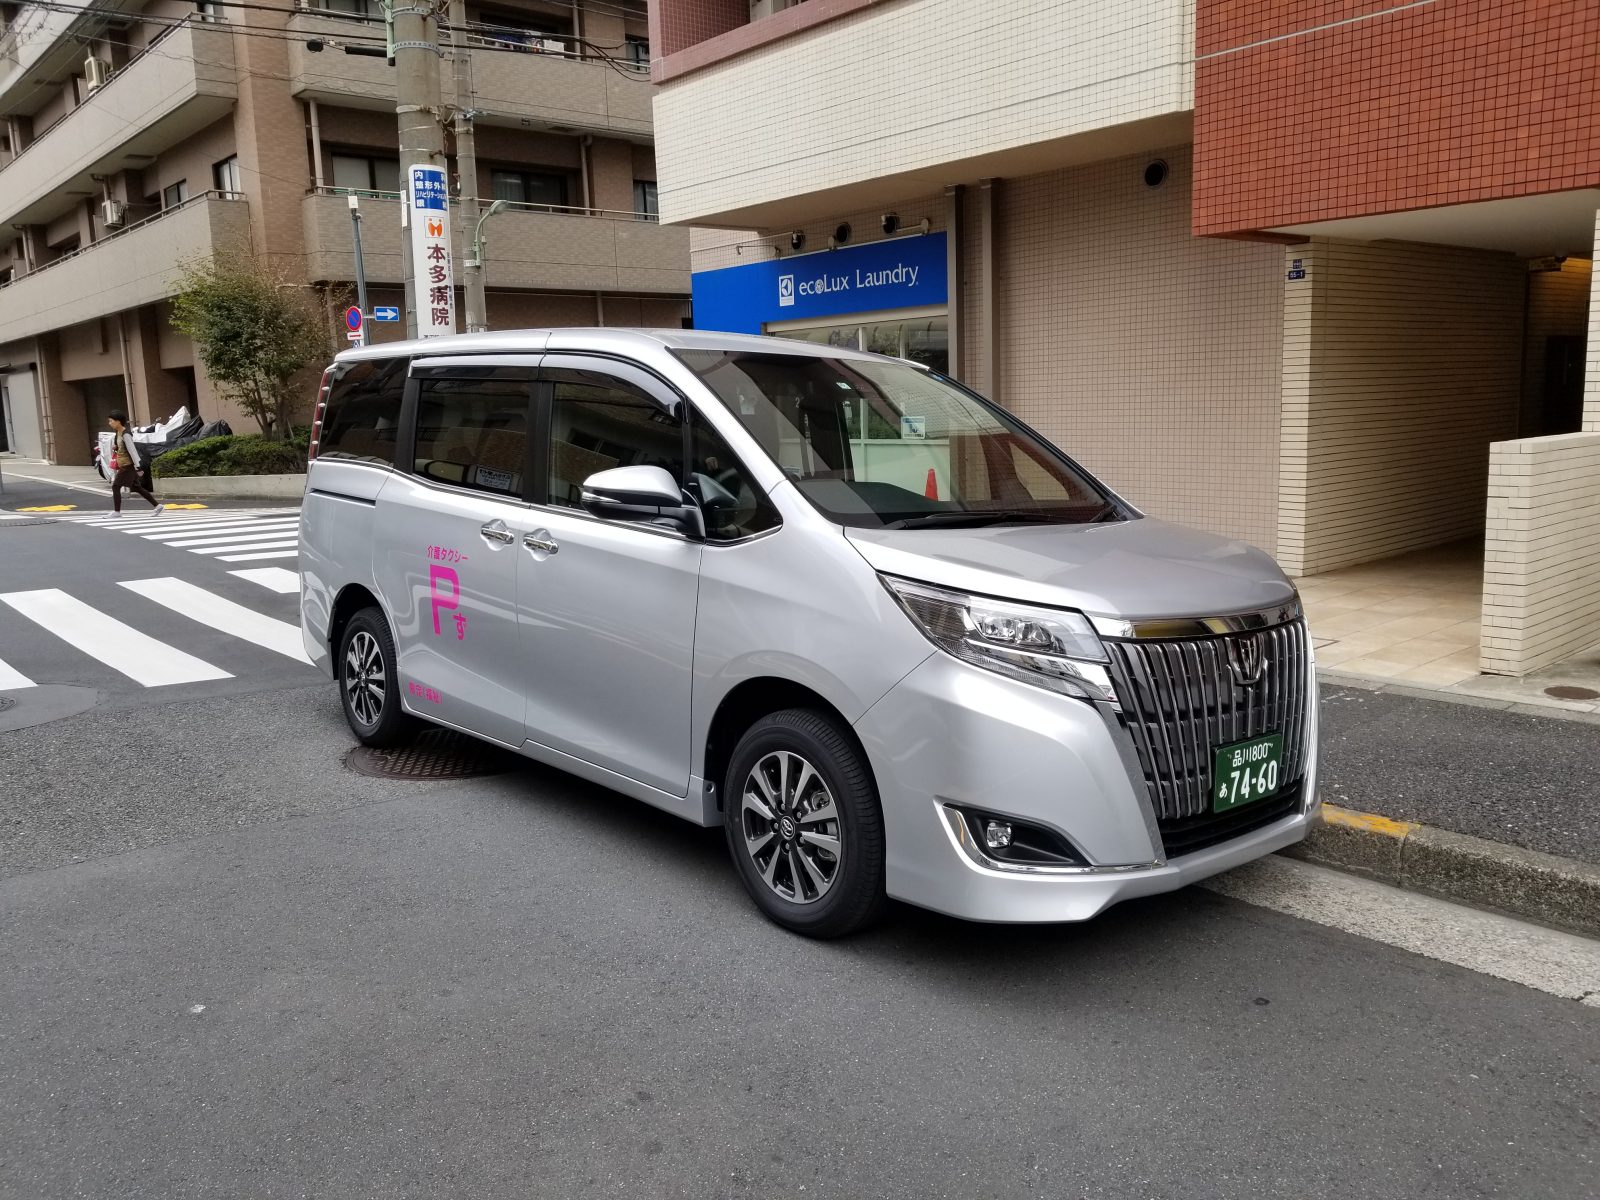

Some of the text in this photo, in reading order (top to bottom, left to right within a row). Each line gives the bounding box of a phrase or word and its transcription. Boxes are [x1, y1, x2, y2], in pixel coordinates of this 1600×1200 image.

[427, 243, 449, 326] 本多病院
[856, 263, 919, 288] Laundry
[428, 545, 469, 563] 介護タクシー
[1231, 760, 1278, 804] 74-60
